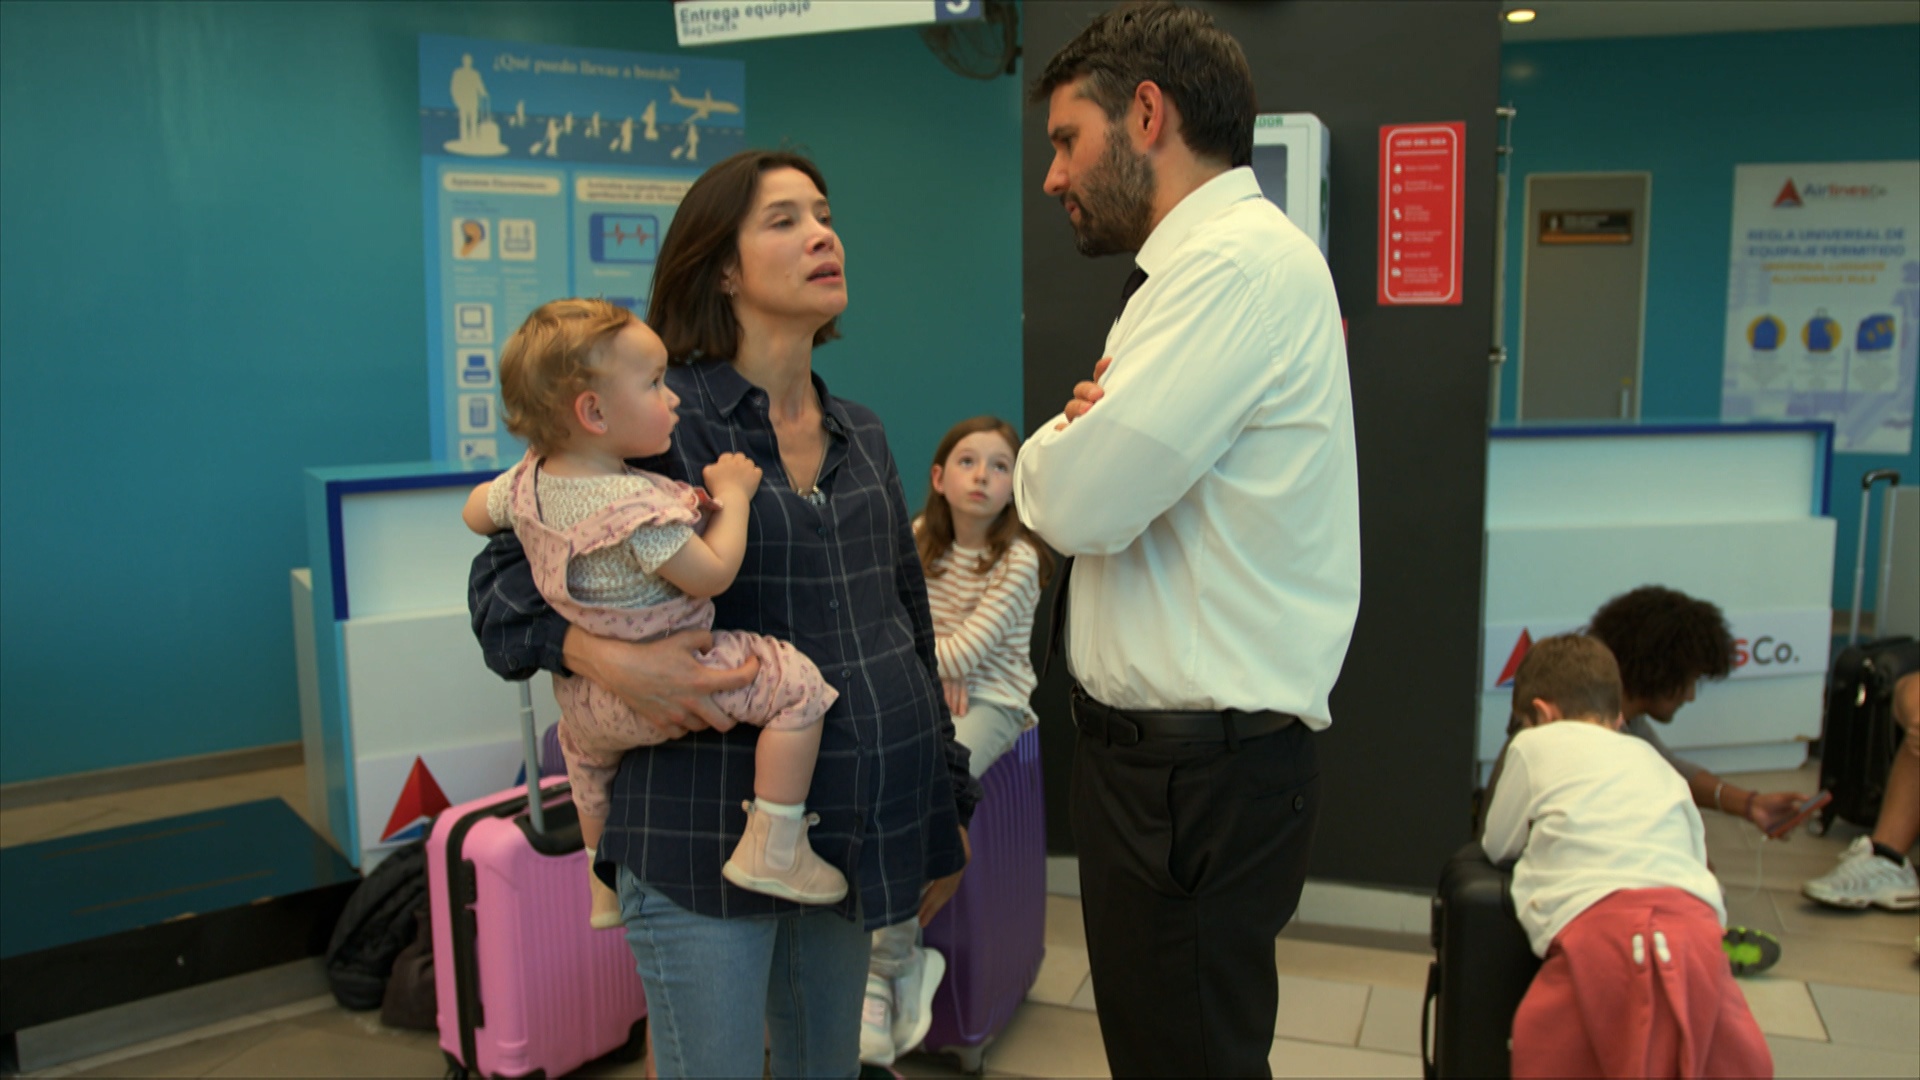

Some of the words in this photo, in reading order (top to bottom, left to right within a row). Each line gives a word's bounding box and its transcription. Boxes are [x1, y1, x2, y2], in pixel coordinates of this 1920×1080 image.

[680, 7, 739, 23] Entrega
[745, 0, 810, 18] equipaje
[534, 57, 578, 74] puedo
[580, 60, 618, 76] llevar
[1747, 229, 1794, 240] REGLA
[1799, 229, 1880, 240] UNIVERSAL
[1885, 228, 1904, 239] DE
[1748, 246, 1817, 257] EQUIPAJE
[1822, 246, 1905, 257] PERMITIDO
